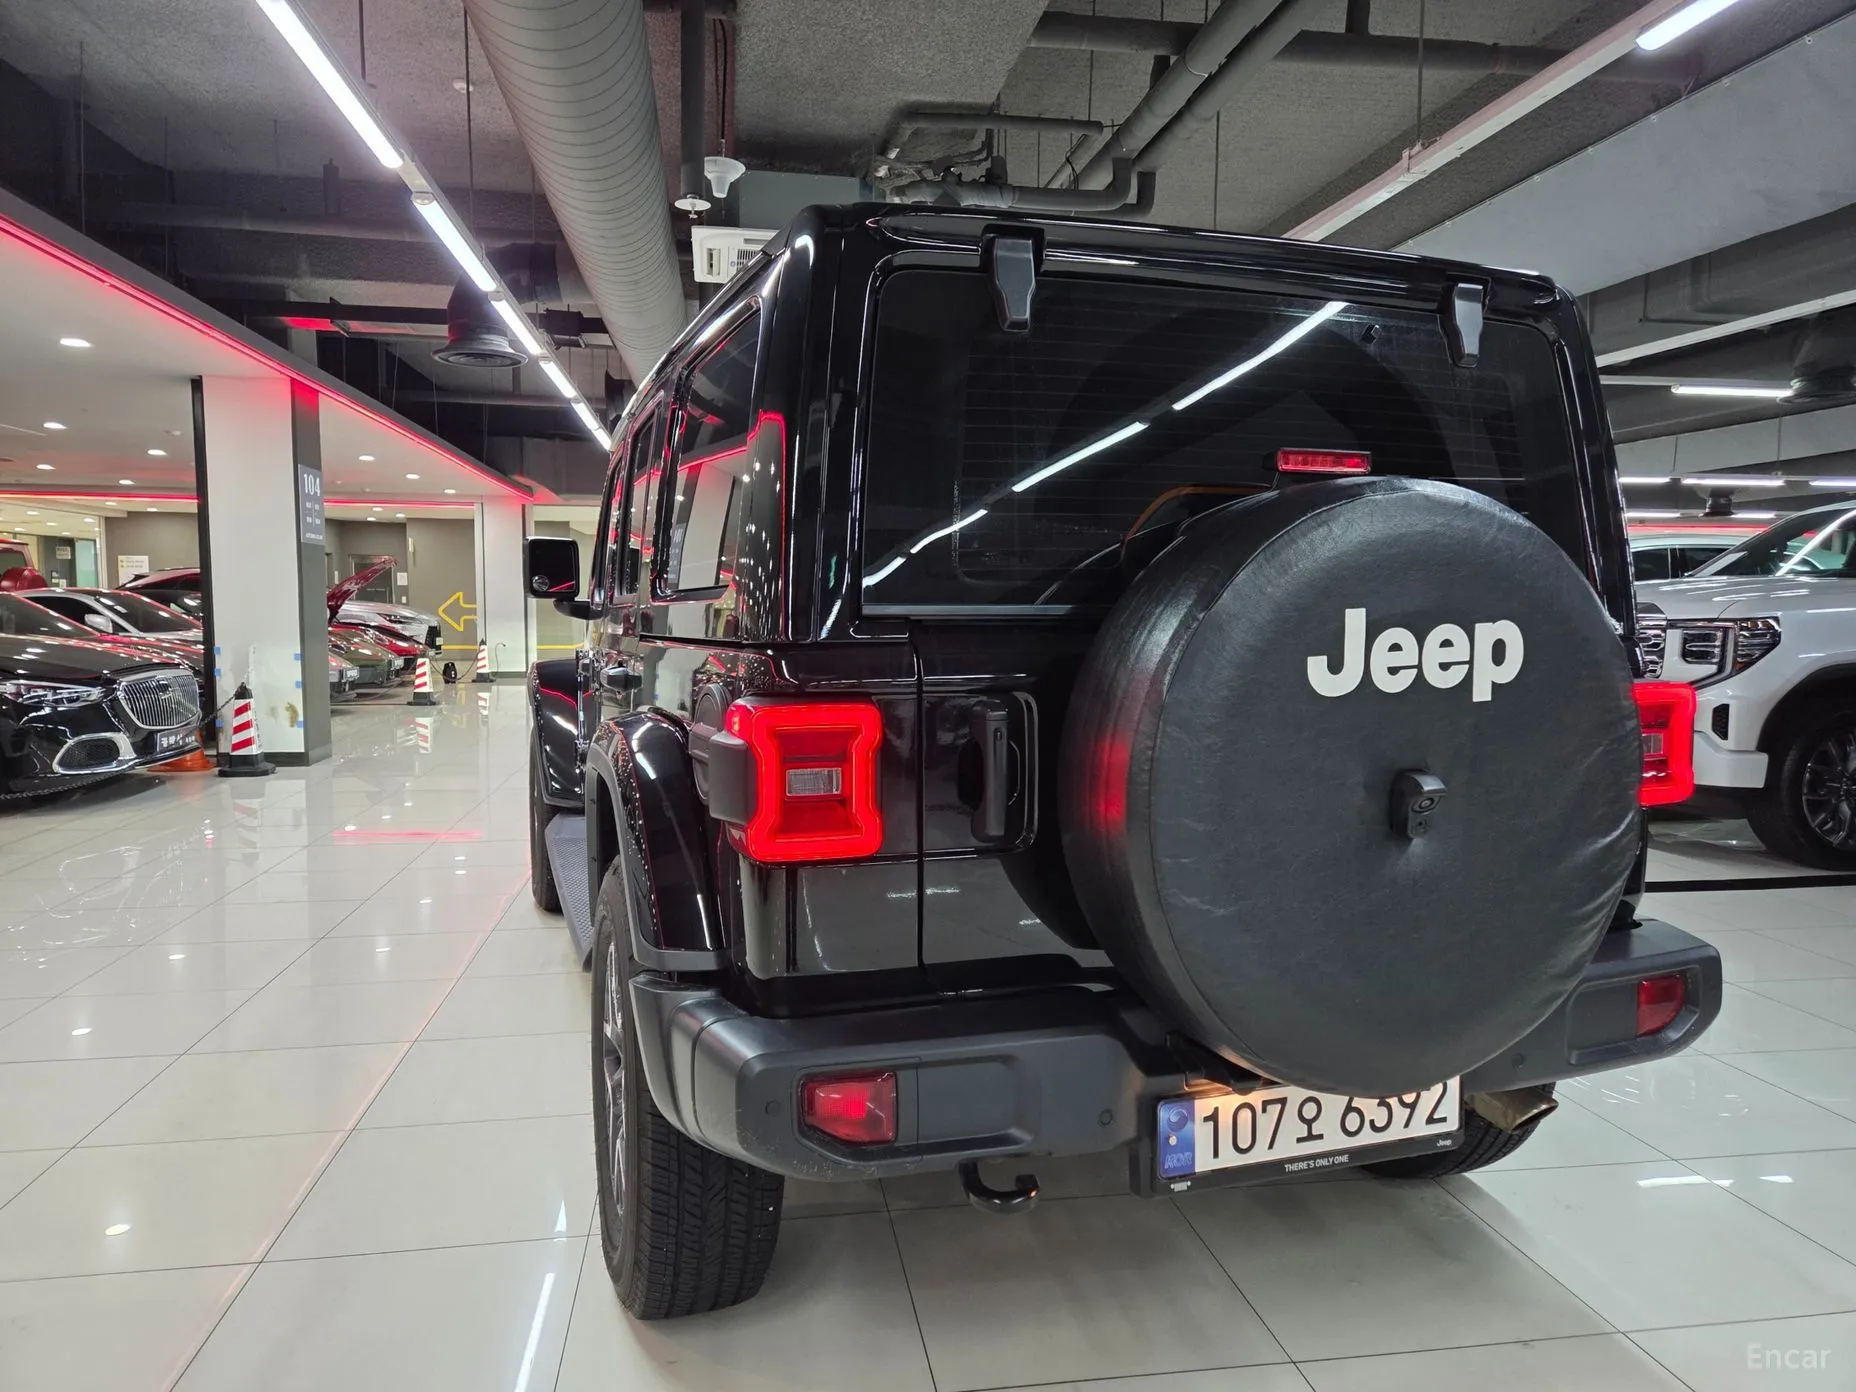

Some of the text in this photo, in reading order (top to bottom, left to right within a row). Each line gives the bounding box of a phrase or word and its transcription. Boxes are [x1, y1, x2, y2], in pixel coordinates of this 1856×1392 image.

[303, 473, 321, 497] 104
[1307, 607, 1525, 702] Jeep
[1203, 1081, 1448, 1159] 107오 6392
[1284, 1154, 1349, 1173] THERE'S ONLY ONE
